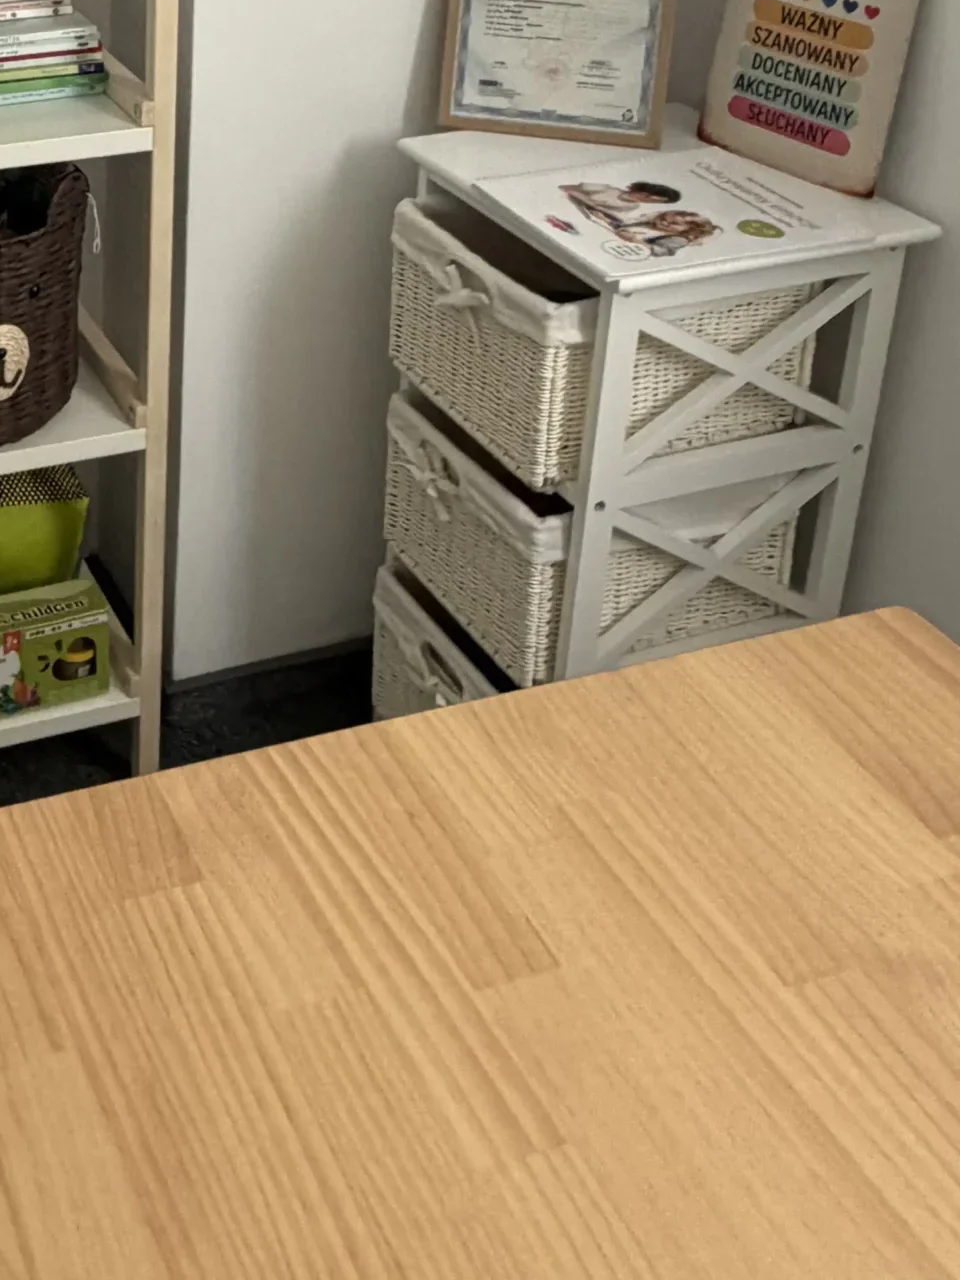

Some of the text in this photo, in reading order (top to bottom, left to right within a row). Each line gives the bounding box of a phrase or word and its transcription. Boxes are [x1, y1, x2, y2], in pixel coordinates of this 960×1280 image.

[781, 4, 844, 40] WAŻNY
[751, 26, 860, 74] SZANOWANY
[751, 52, 848, 99] DOCENIANY
[734, 73, 855, 128] AKCEPTOWANY
[748, 102, 833, 146] SŁUCHANY
[10, 599, 86, 623] ChildGen
